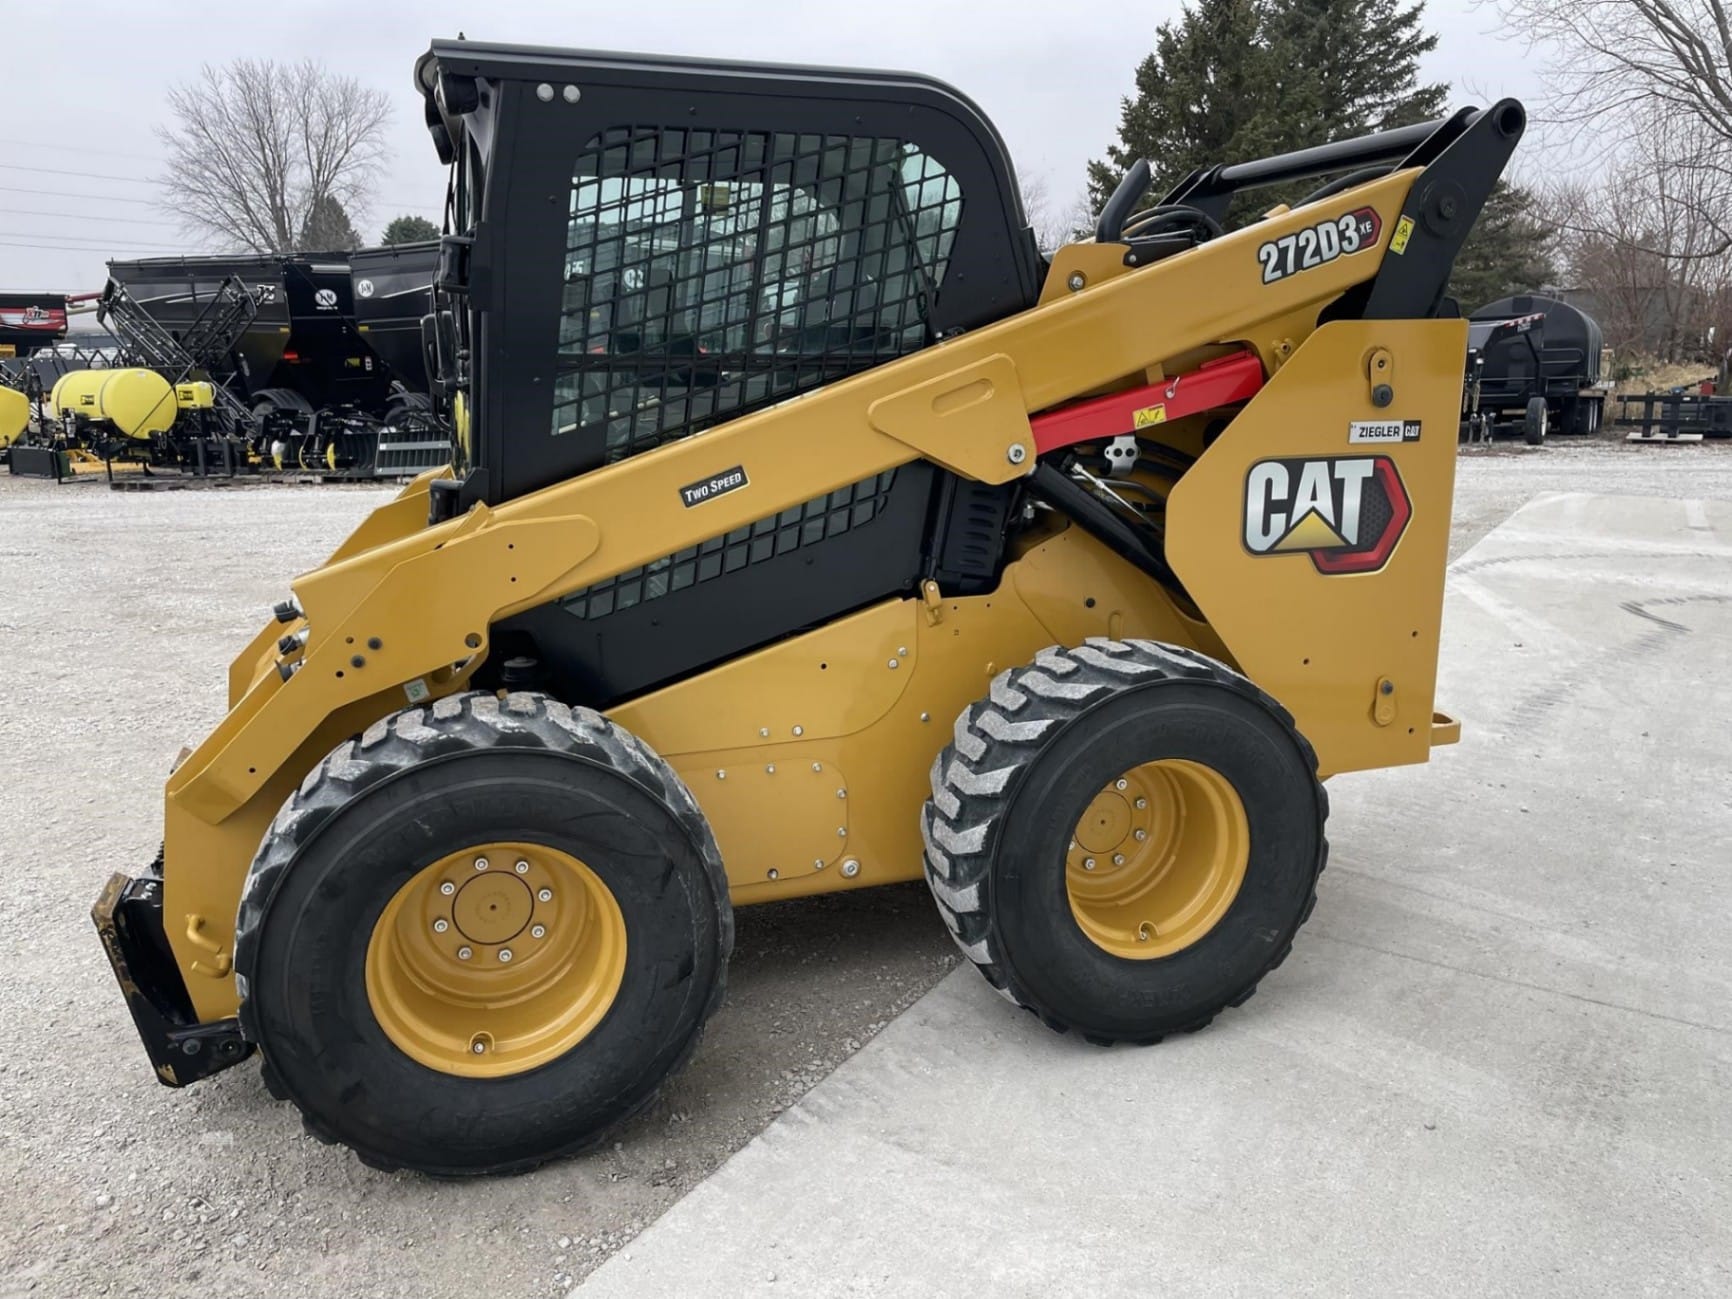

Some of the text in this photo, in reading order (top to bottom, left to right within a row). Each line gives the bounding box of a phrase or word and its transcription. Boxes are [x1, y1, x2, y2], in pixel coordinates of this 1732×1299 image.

[1259, 214, 1373, 283] 272D3 XE
[1359, 425, 1401, 438] ZIEGLER
[1246, 459, 1374, 552] CAT
